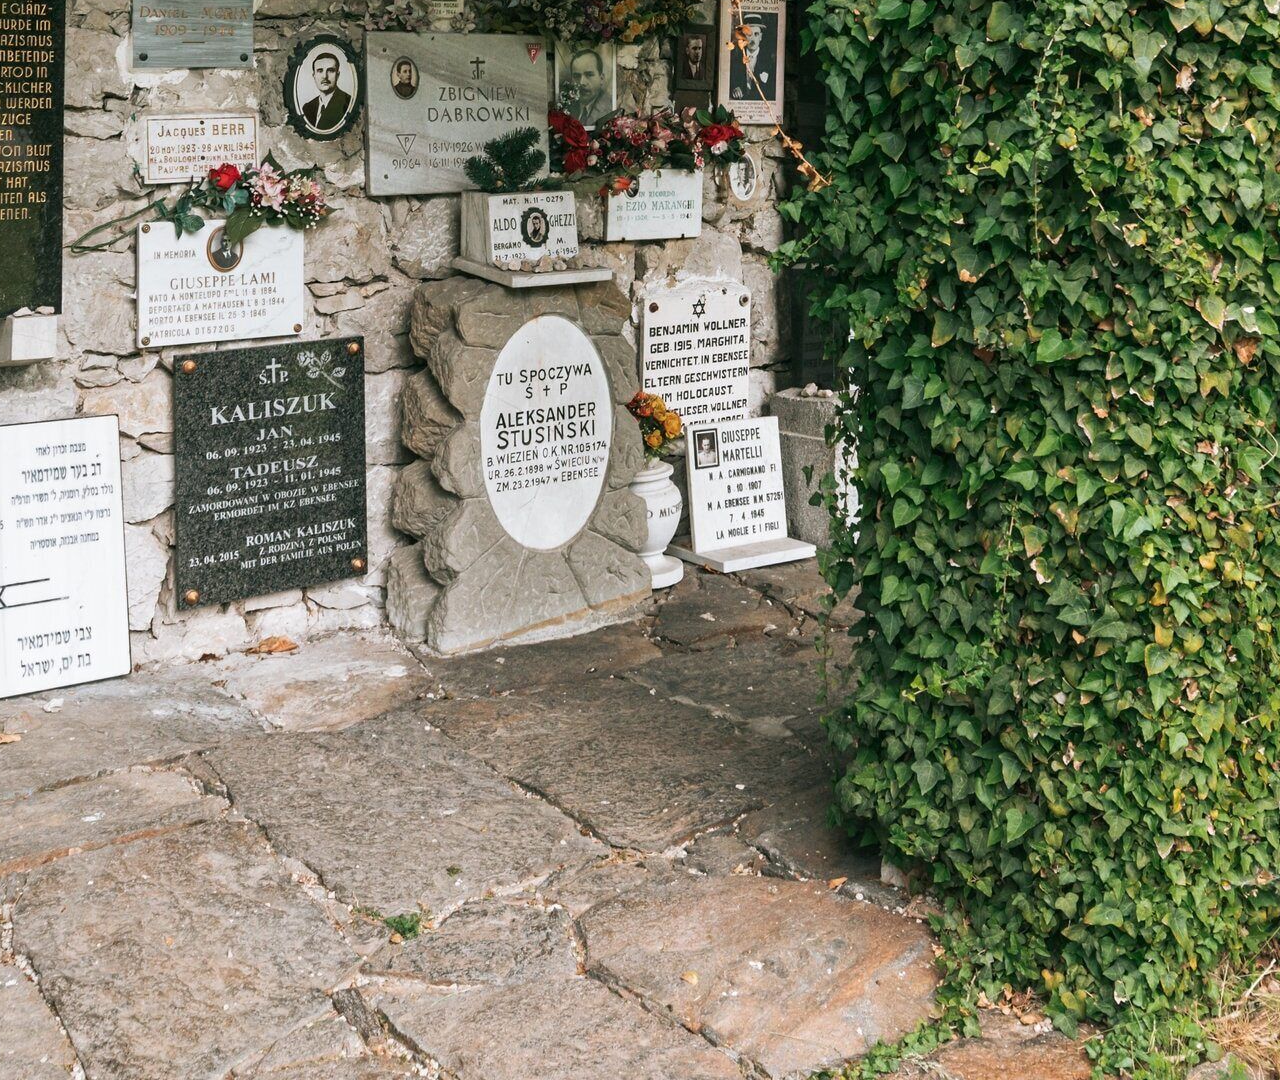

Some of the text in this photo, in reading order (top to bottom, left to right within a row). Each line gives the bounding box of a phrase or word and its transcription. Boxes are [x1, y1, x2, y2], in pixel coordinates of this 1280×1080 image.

[36, 19, 51, 31] IM
[439, 87, 517, 101] ZBIGNIEW
[428, 107, 530, 123] DĄBROWSKI
[213, 124, 245, 136] BERR
[626, 202, 646, 211] EZIO
[494, 214, 575, 231] ALDO GHEZZI
[494, 241, 521, 250] BERGAMO
[154, 250, 196, 260] IN MEMORIA
[170, 272, 275, 290] GIUSEPPE LAMI
[649, 323, 699, 337] BENJAMIN
[712, 350, 748, 363] EBENSEE
[497, 372, 512, 386] TU
[645, 367, 748, 388] ELTERN GESCHWISTERN
[560, 383, 567, 395] P
[662, 393, 672, 402] IM
[210, 392, 336, 426] KALISZUK
[496, 402, 596, 430] ALEKSANDER
[256, 425, 293, 441] JAN
[497, 420, 595, 450] STUSIŃSKI
[722, 428, 760, 443] GIUSEPPE
[245, 433, 341, 456] 1923 1945
[723, 446, 762, 462] MARTELLI
[231, 456, 319, 480] TADEUSZ
[561, 467, 598, 482] EBENSEE
[728, 465, 765, 478] CARMIGNANO
[189, 479, 359, 514] ZAMORDOWANI OBOZIE EBENSEE
[214, 494, 337, 521] ERMORDET IM KZ EBENSEE
[246, 518, 357, 546] ROMAN KALISZUK
[317, 532, 346, 545] POLSKI
[716, 521, 779, 540] LA MOGLIE FIGLI
[260, 541, 361, 566] DER FAMILIE AUS POLEN
[18, 626, 92, 651] צבי שמידמאיר
[78, 652, 91, 667] בת
